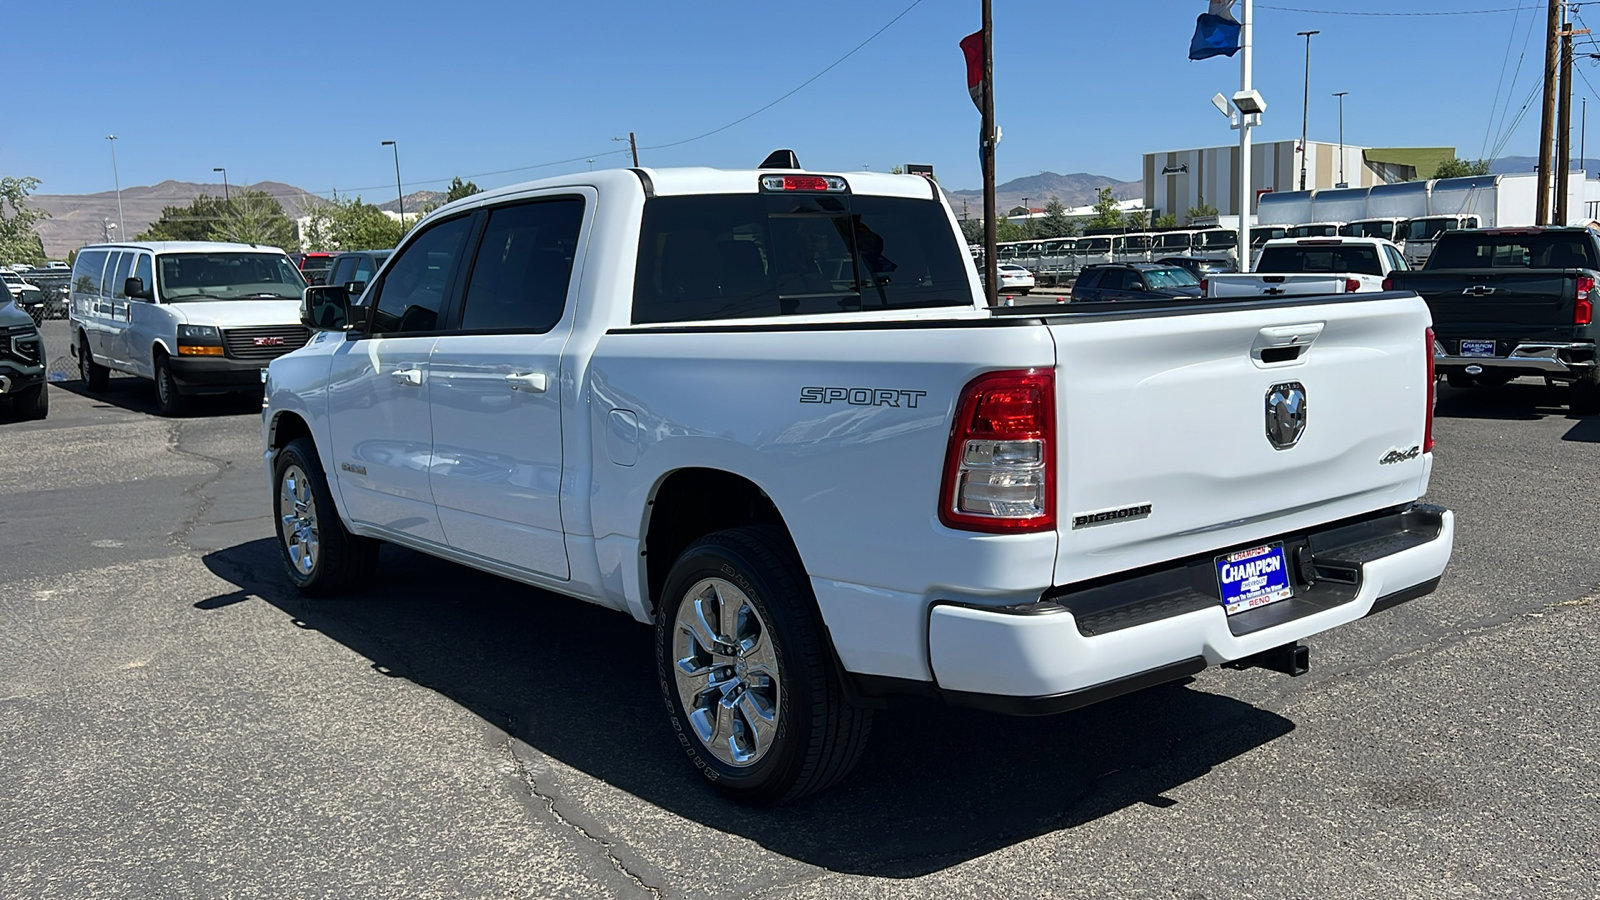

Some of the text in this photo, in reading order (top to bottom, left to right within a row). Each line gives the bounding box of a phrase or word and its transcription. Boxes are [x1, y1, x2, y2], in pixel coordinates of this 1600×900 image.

[799, 386, 927, 408] SPORT
[1380, 445, 1420, 465] 4x4
[1073, 504, 1152, 527] BIGHORN
[1233, 546, 1266, 561] CHAMPION
[1221, 555, 1281, 584] CHAMPION
[1242, 577, 1266, 589] CHEVROLET
[1248, 595, 1270, 608] RENO
[656, 606, 720, 781] BRIDGESTONE
